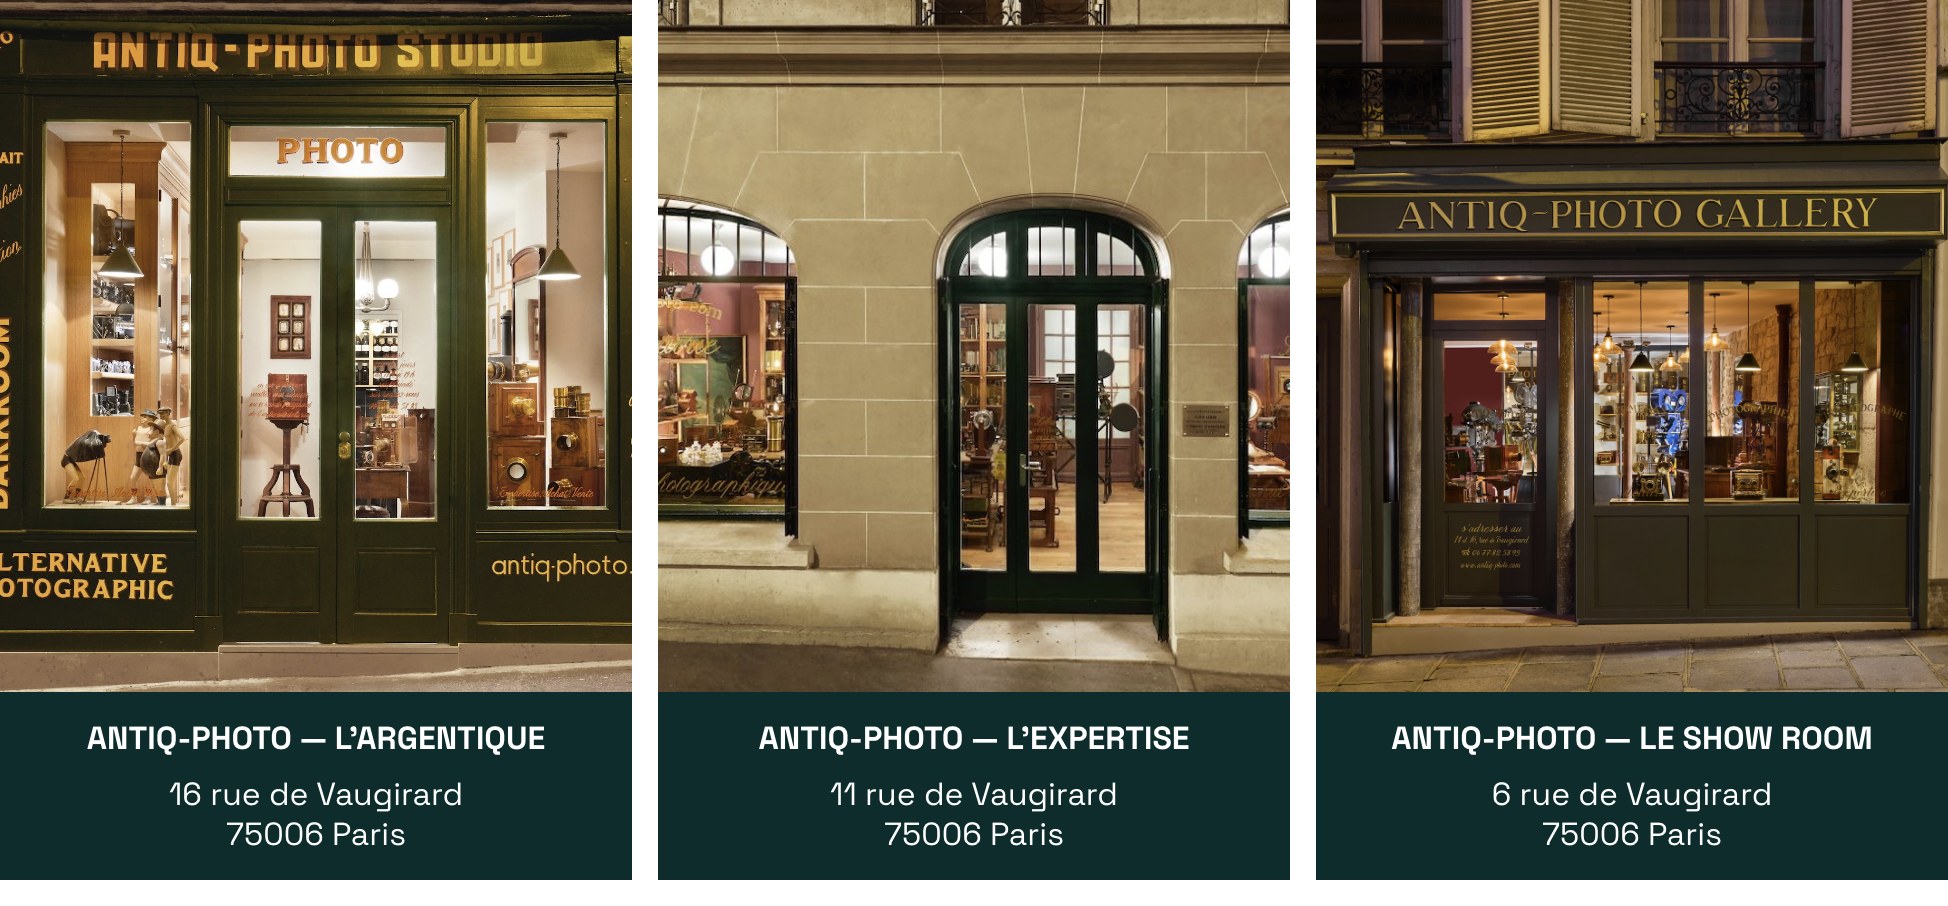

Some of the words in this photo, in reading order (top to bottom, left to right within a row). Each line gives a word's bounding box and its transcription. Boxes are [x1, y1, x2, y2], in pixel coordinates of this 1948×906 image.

[397, 31, 544, 70] STUDIO
[276, 137, 404, 164] PHOTO
[1396, 199, 1683, 231] ANTIQ-PHOTO
[1696, 197, 1878, 229] GALLERY
[572, 486, 594, 498] Vente
